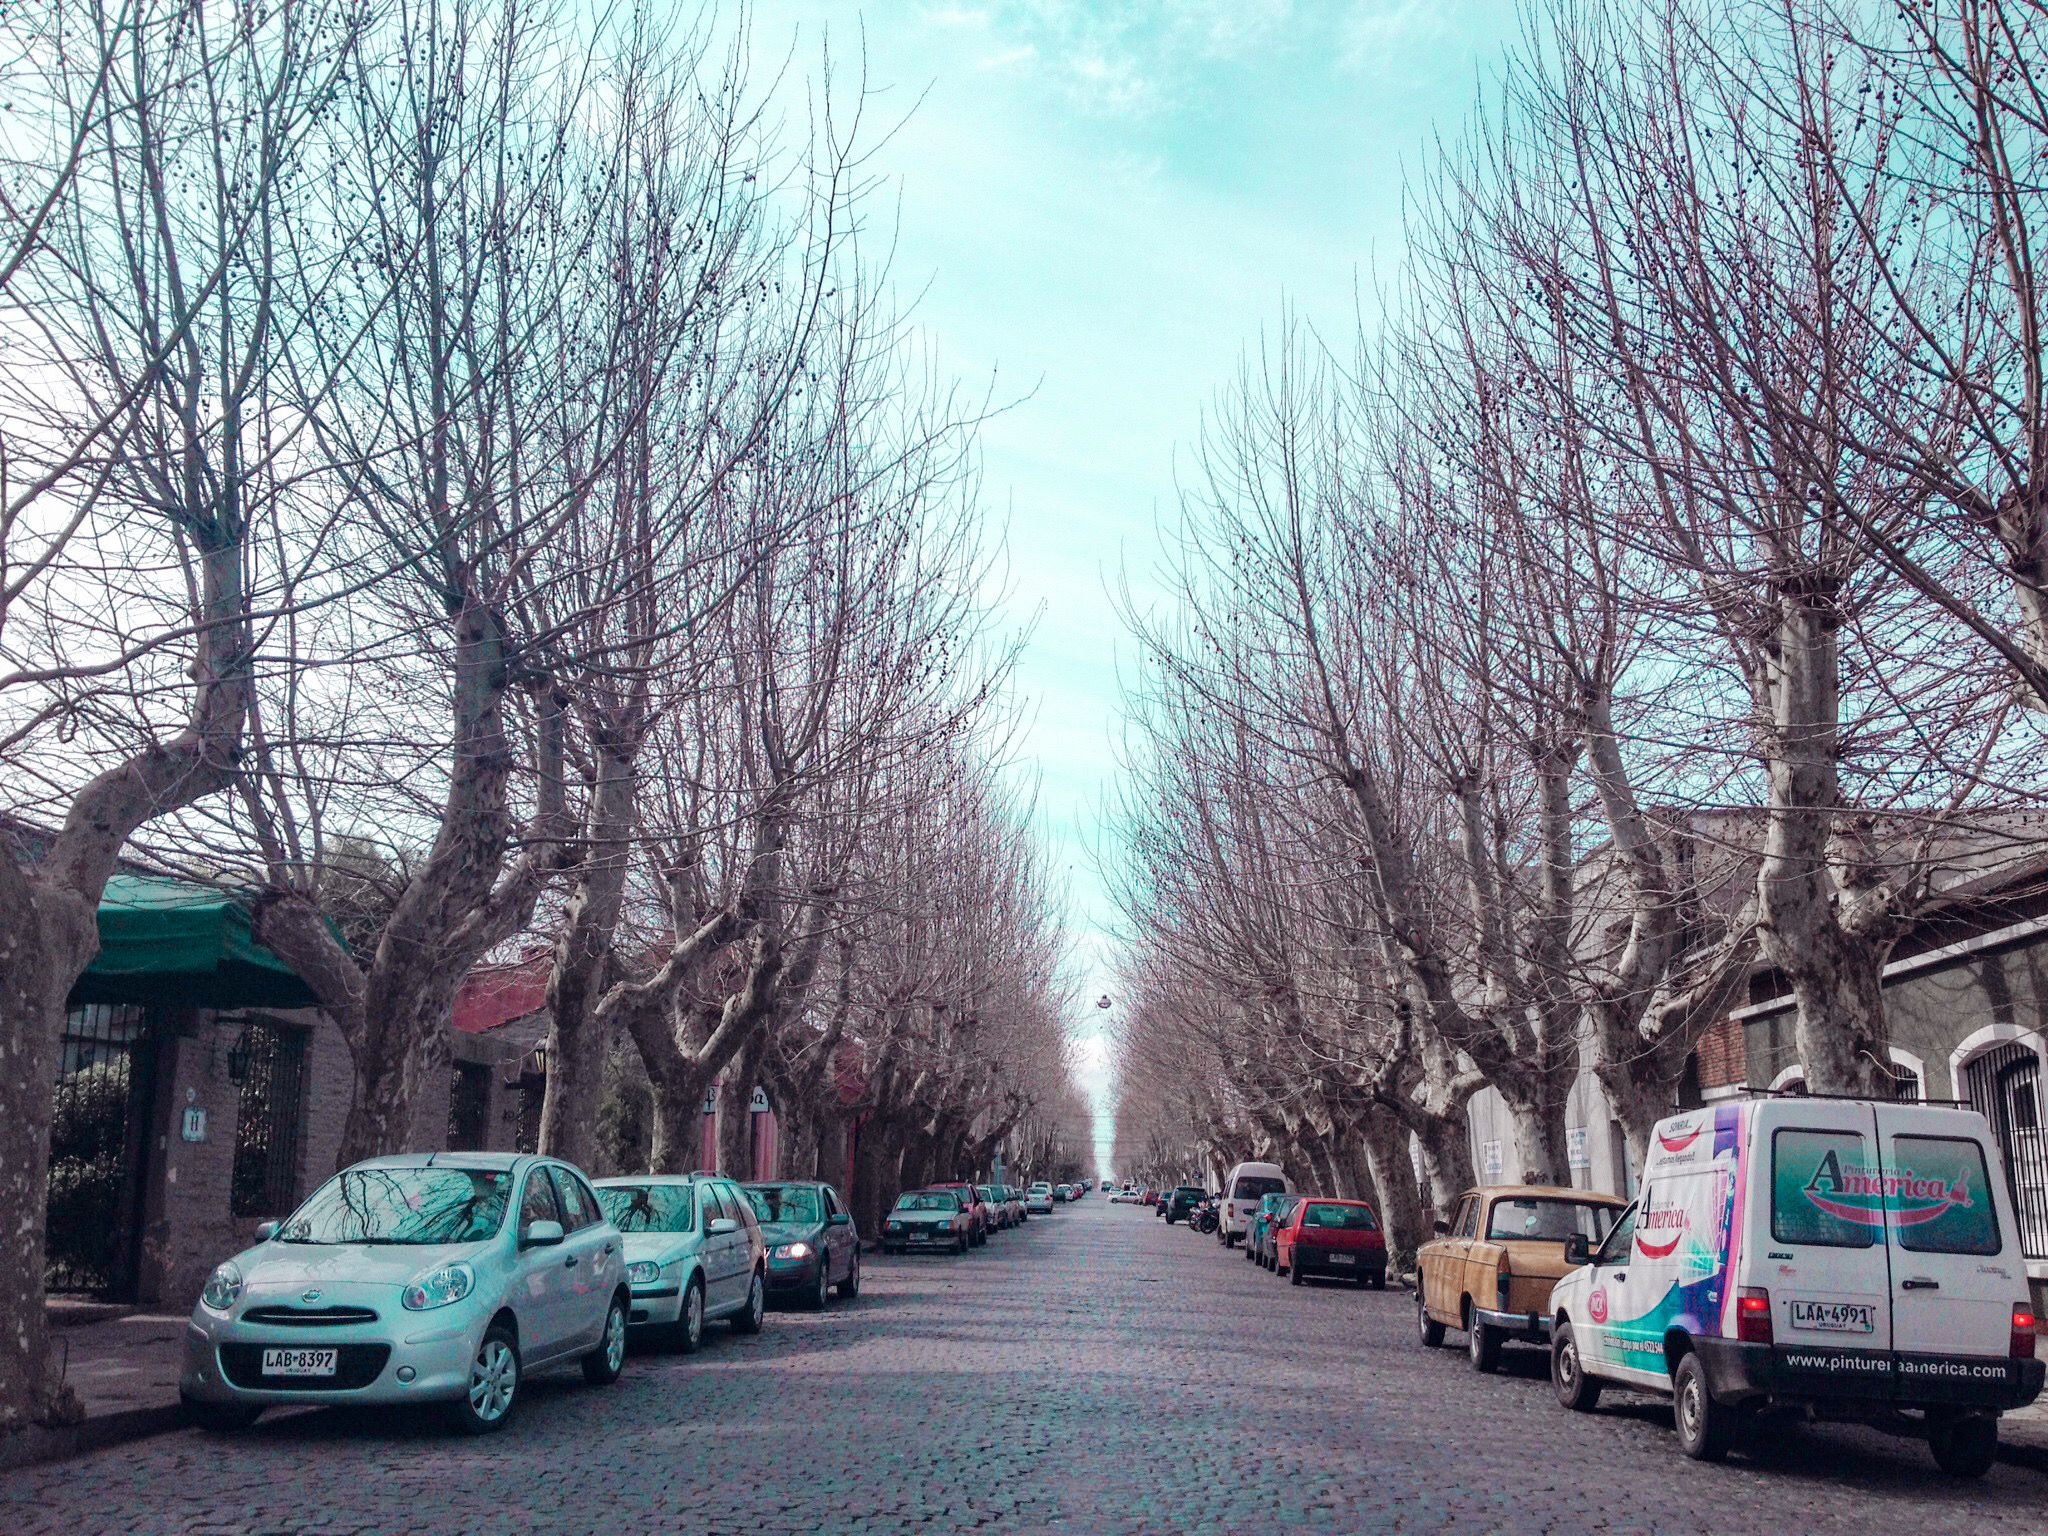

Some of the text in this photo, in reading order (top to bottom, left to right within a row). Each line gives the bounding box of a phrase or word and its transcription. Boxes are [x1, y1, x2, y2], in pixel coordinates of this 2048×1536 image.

[1635, 1185, 1684, 1229] America
[1796, 1303, 1869, 1325] LAA 4991
[266, 1352, 333, 1368] LAB 8397
[1787, 1354, 2006, 1378] www.pintureraamerica.com
